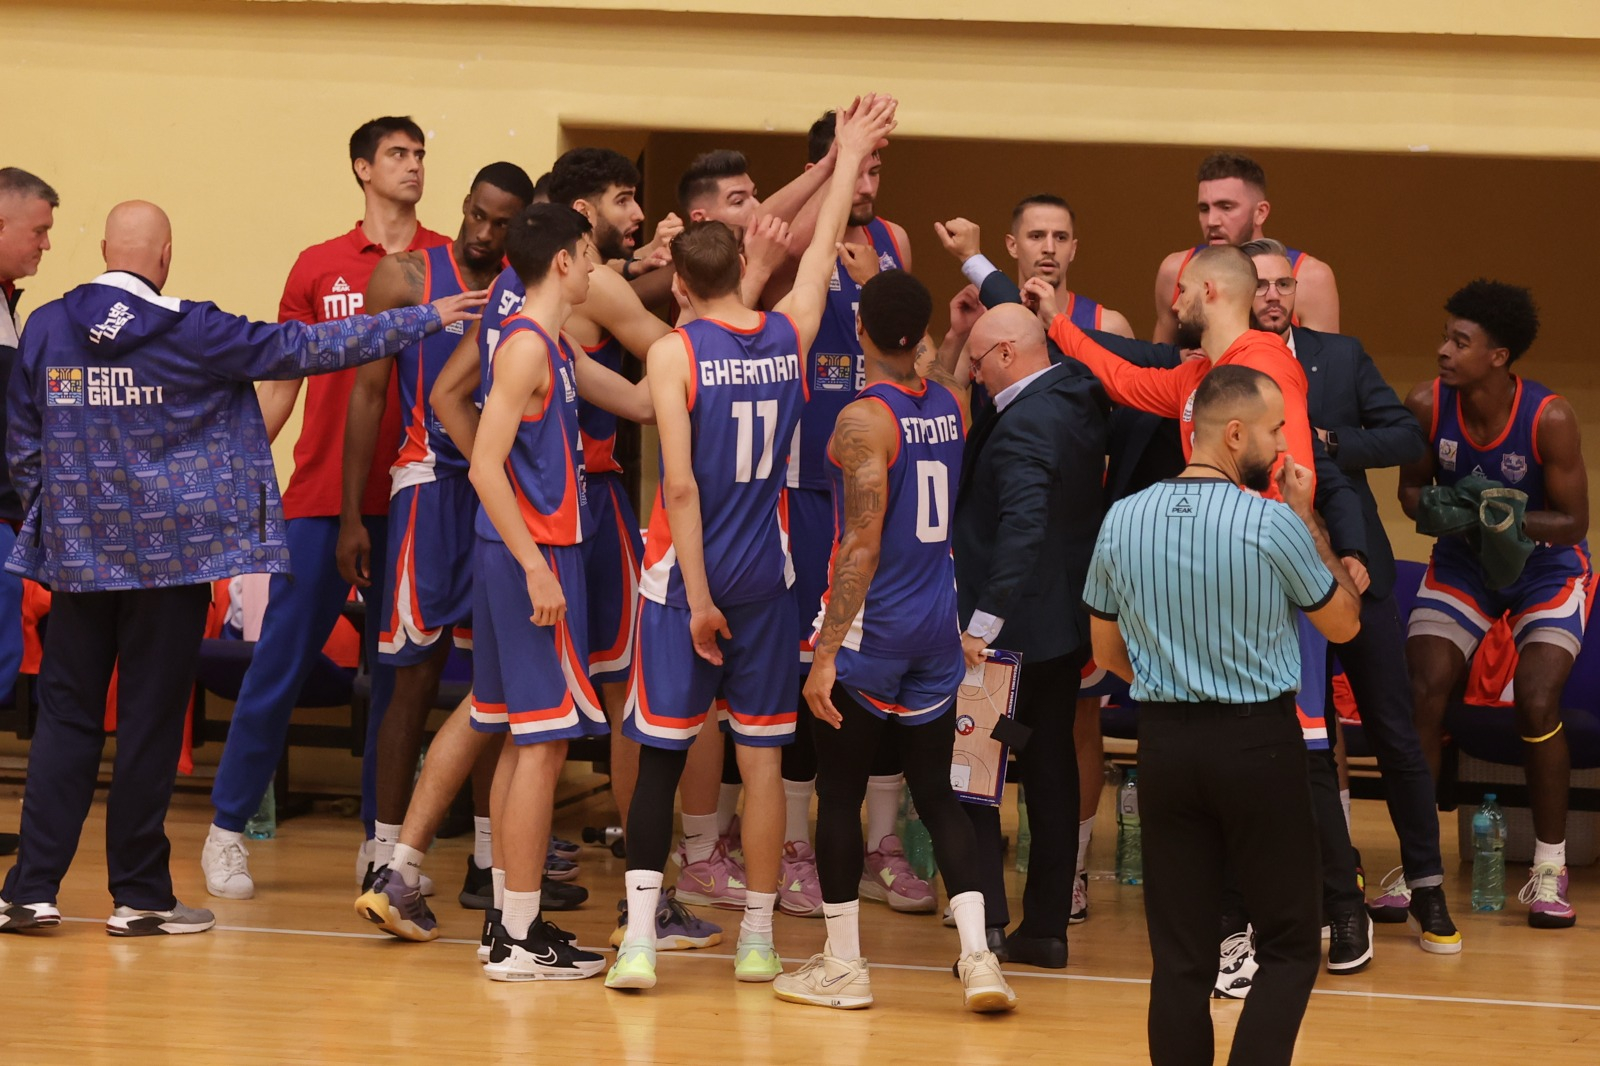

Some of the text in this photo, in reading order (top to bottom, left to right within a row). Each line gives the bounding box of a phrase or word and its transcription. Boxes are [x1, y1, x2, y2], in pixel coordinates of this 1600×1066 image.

[323, 292, 364, 319] MP
[87, 366, 133, 387] CSM
[699, 354, 799, 386] GHERMAN
[87, 386, 163, 406] GALATI
[731, 399, 778, 483] 11
[915, 459, 949, 543] 0
